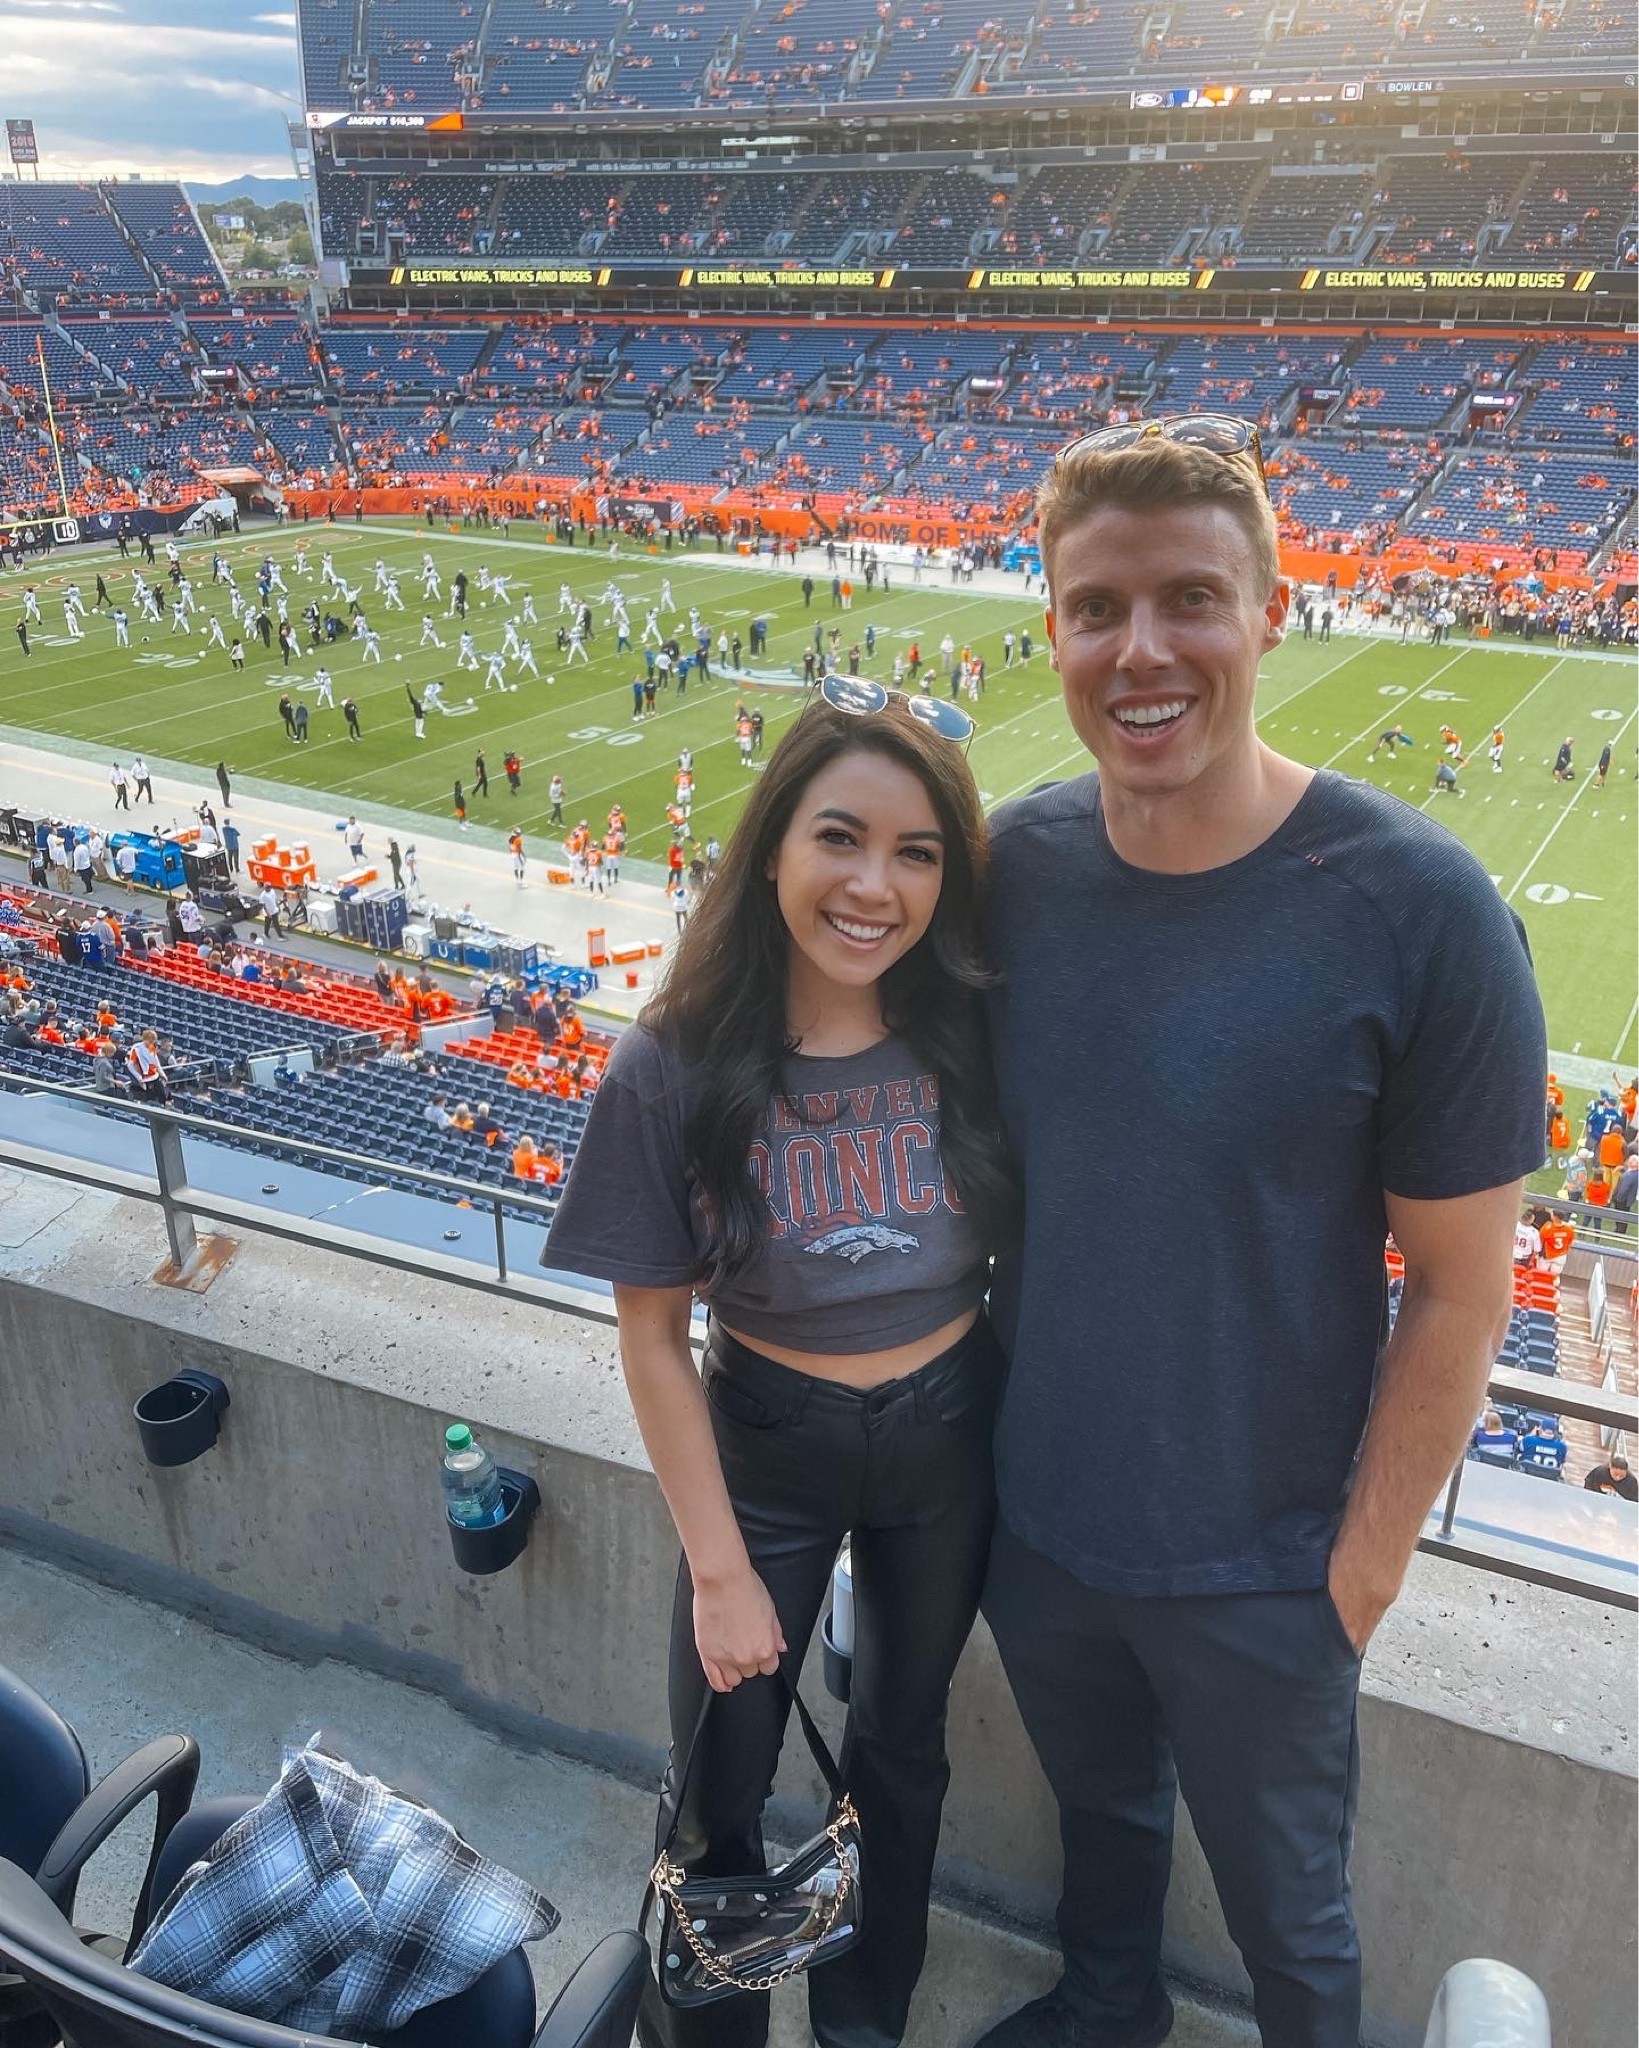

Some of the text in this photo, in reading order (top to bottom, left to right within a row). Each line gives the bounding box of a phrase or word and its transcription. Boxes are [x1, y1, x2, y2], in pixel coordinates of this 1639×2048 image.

[1388, 81, 1432, 92] BOWLEN
[410, 270, 592, 284] ELECTRIC VANS, TRUCKS AND BUSES
[697, 271, 875, 287] ELECTRIC VANS, TRUCKS AND BUSES
[989, 272, 1190, 288] ELECTRIC VANS, TRUCKS AND BUSES
[1325, 271, 1566, 289] ELECTRIC VANS, TRUCKS AND BUSES
[61, 522, 75, 538] 10
[567, 726, 645, 746] 50
[82, 942, 91, 953] 17
[762, 1074, 941, 1132] ENVER
[1553, 1237, 1564, 1250] 3
